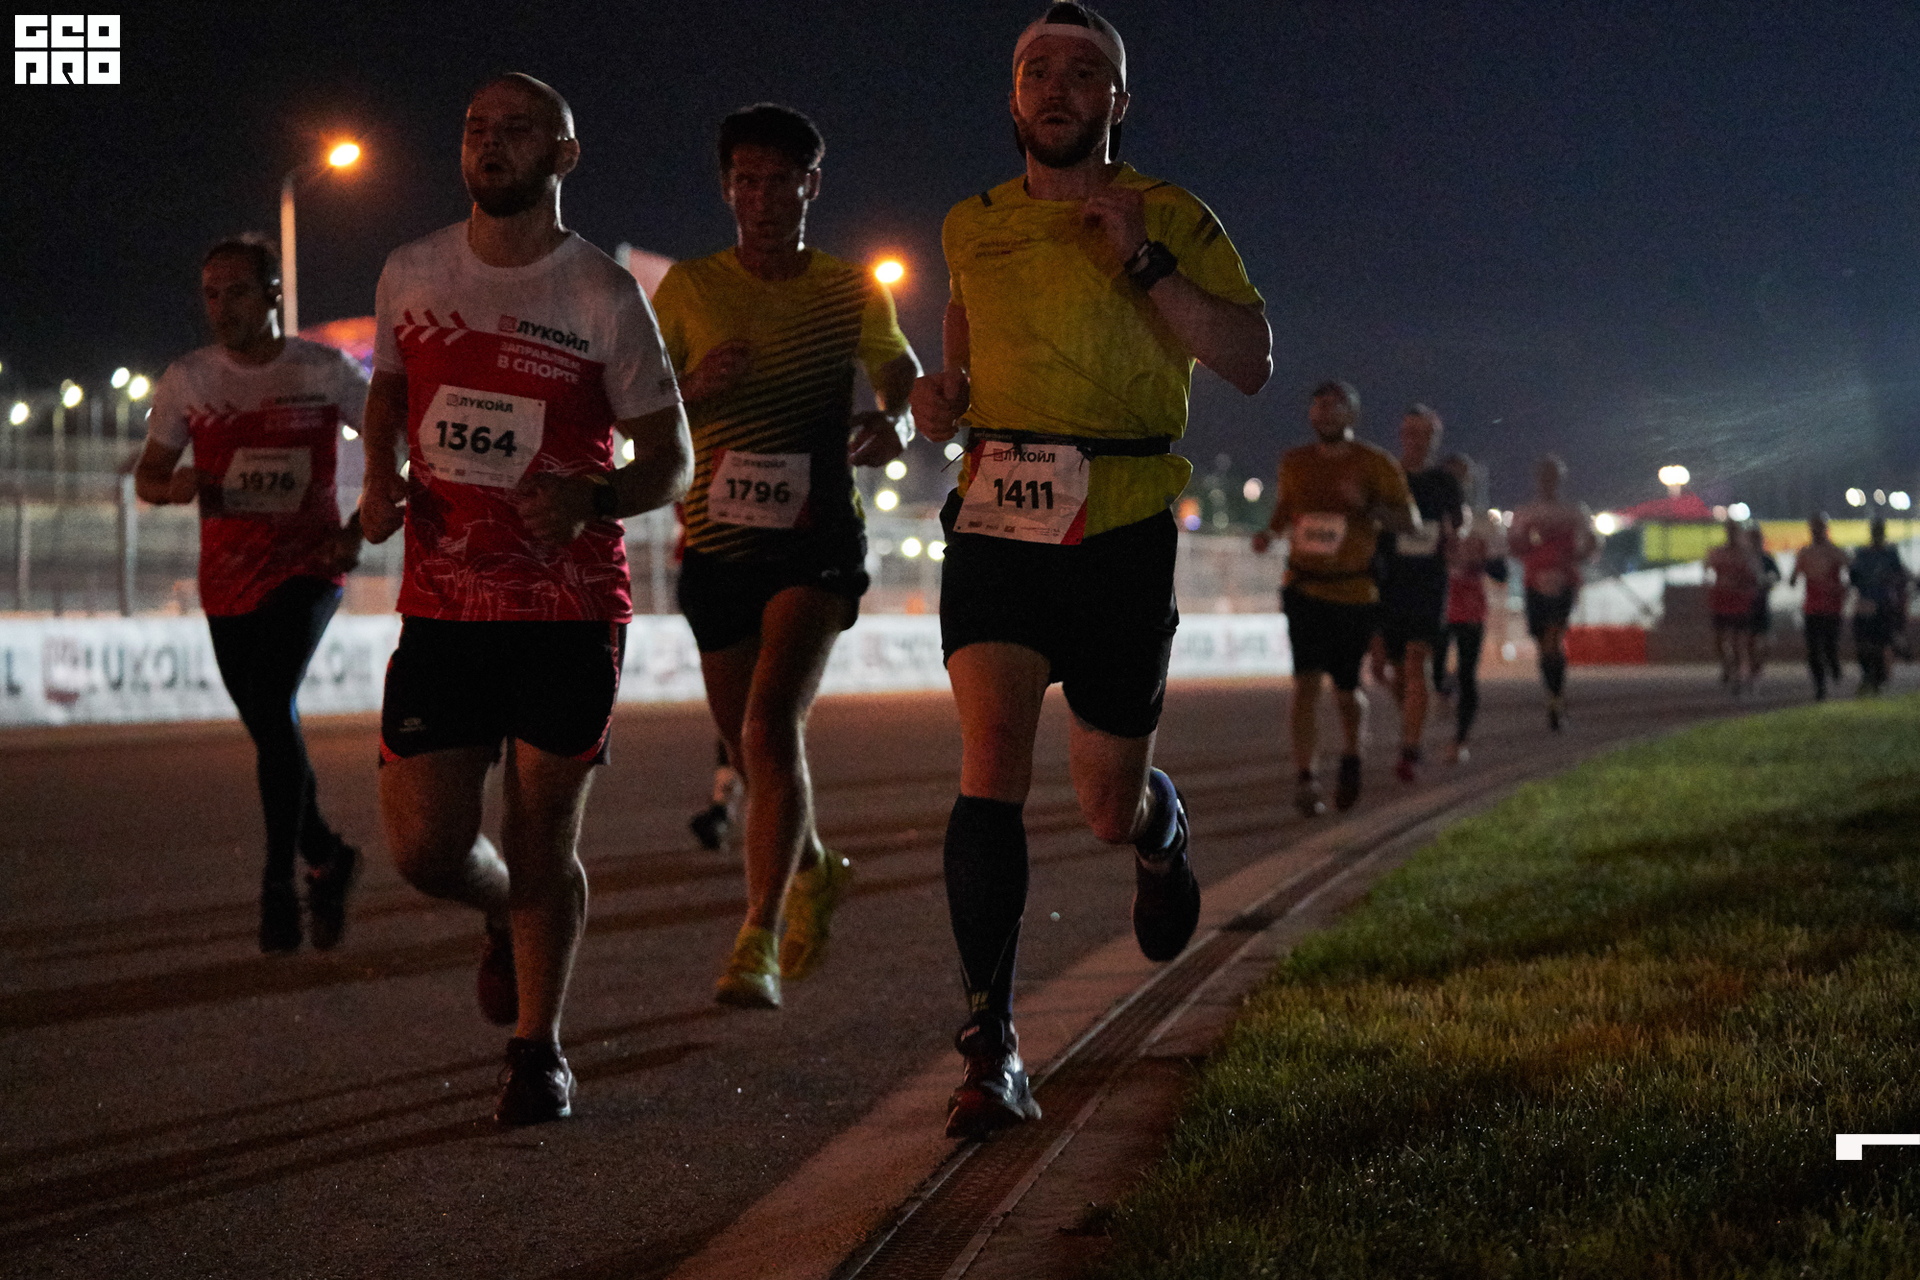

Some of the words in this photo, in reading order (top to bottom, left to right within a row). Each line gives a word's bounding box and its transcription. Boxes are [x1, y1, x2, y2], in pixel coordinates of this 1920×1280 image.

[515, 320, 590, 354] ЛУКОЙЛ
[497, 354, 510, 369] В
[460, 396, 514, 413] ЛУКОЙЛ
[436, 420, 517, 457] 1364
[1004, 450, 1056, 463] ЛУКОЙЛ
[239, 470, 295, 491] 1976
[726, 478, 791, 503] 1796
[994, 478, 1054, 510] 1411
